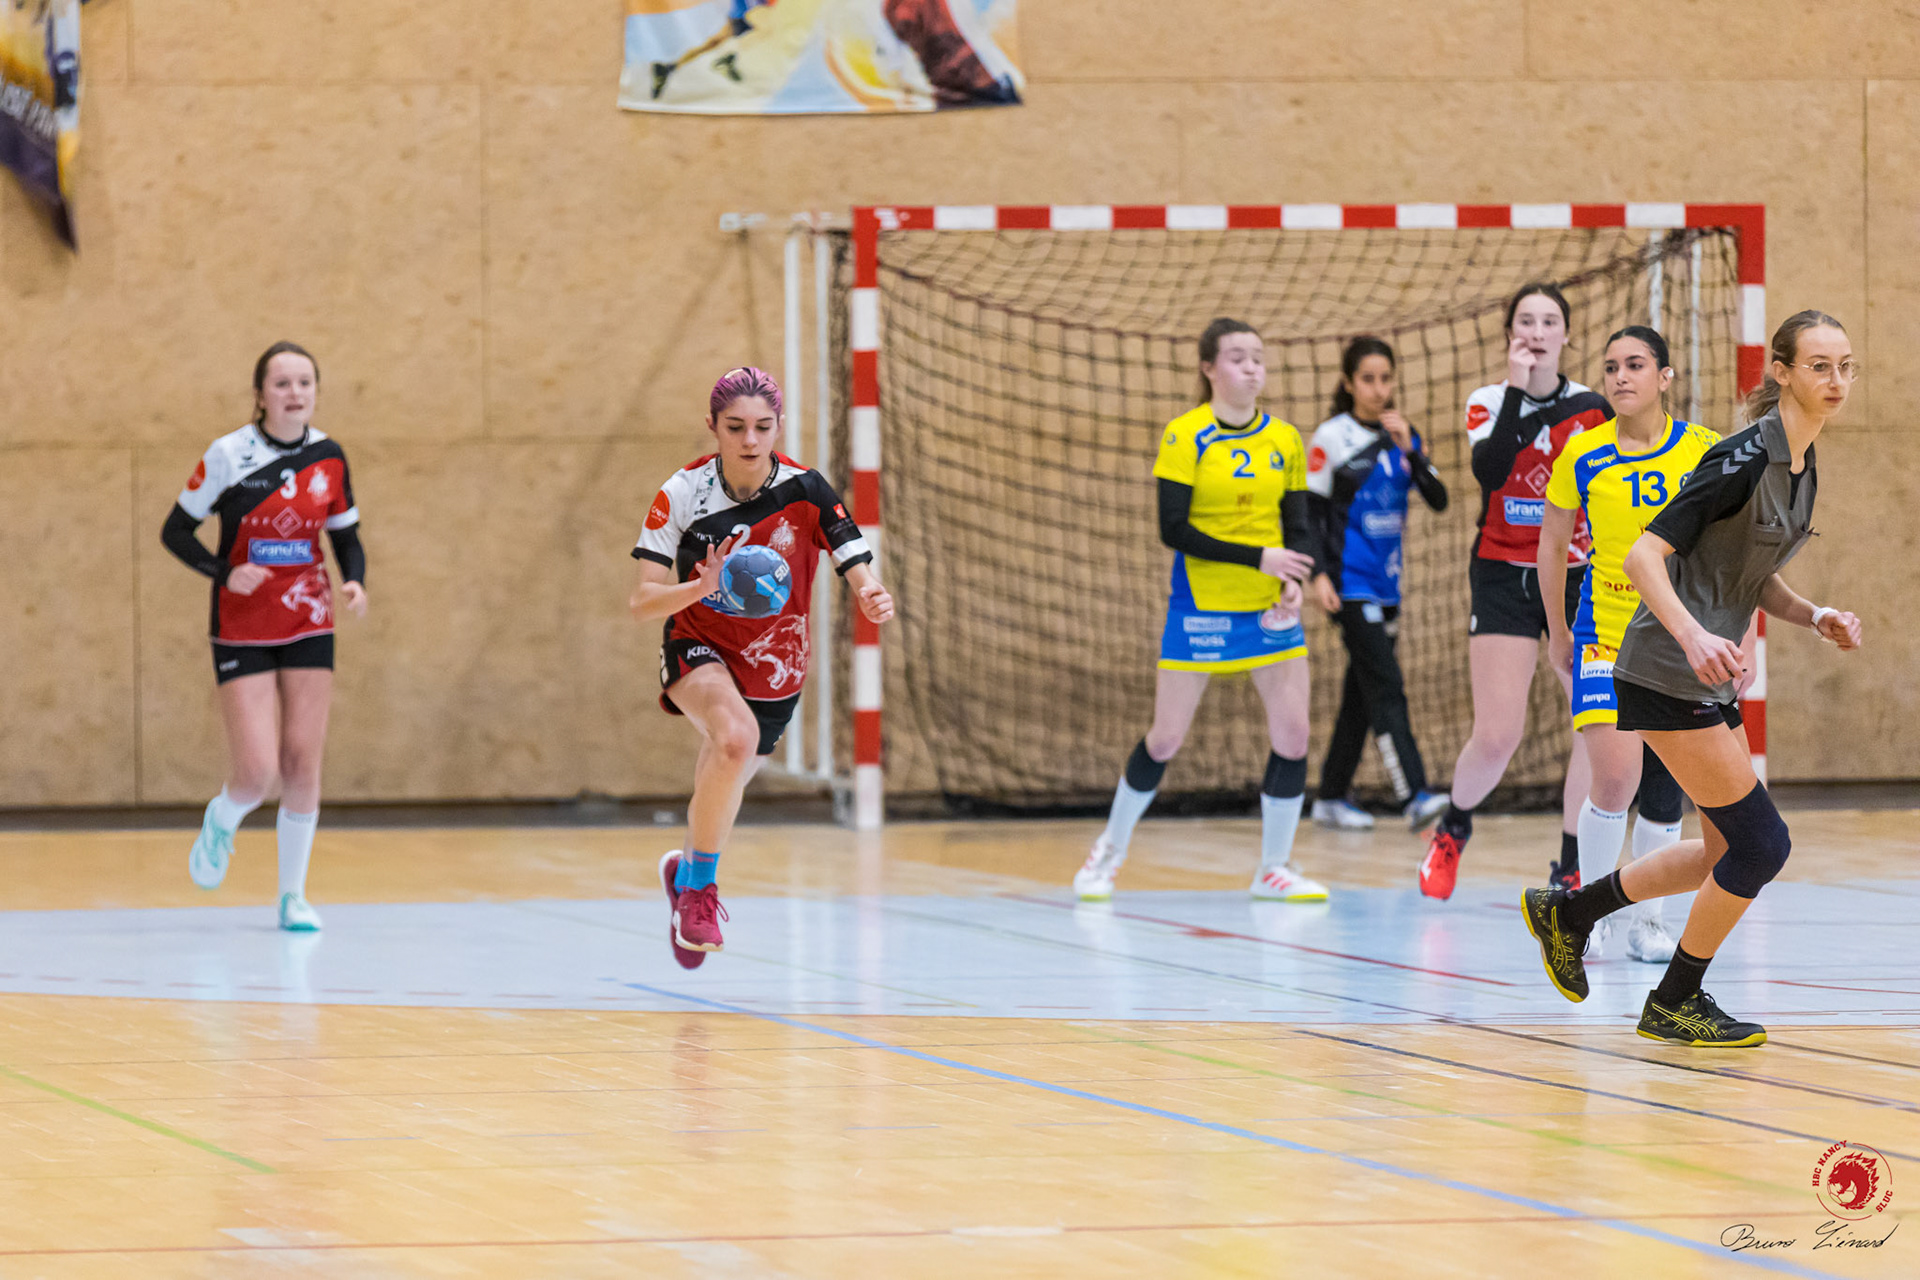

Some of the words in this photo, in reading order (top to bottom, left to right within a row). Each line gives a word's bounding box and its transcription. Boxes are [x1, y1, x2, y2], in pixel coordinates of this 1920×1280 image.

[1534, 424, 1552, 455] 4
[1231, 448, 1255, 478] 2
[1377, 448, 1393, 477] 1
[280, 468, 298, 499] 3
[1622, 470, 1668, 507] 13
[729, 523, 751, 555] 2
